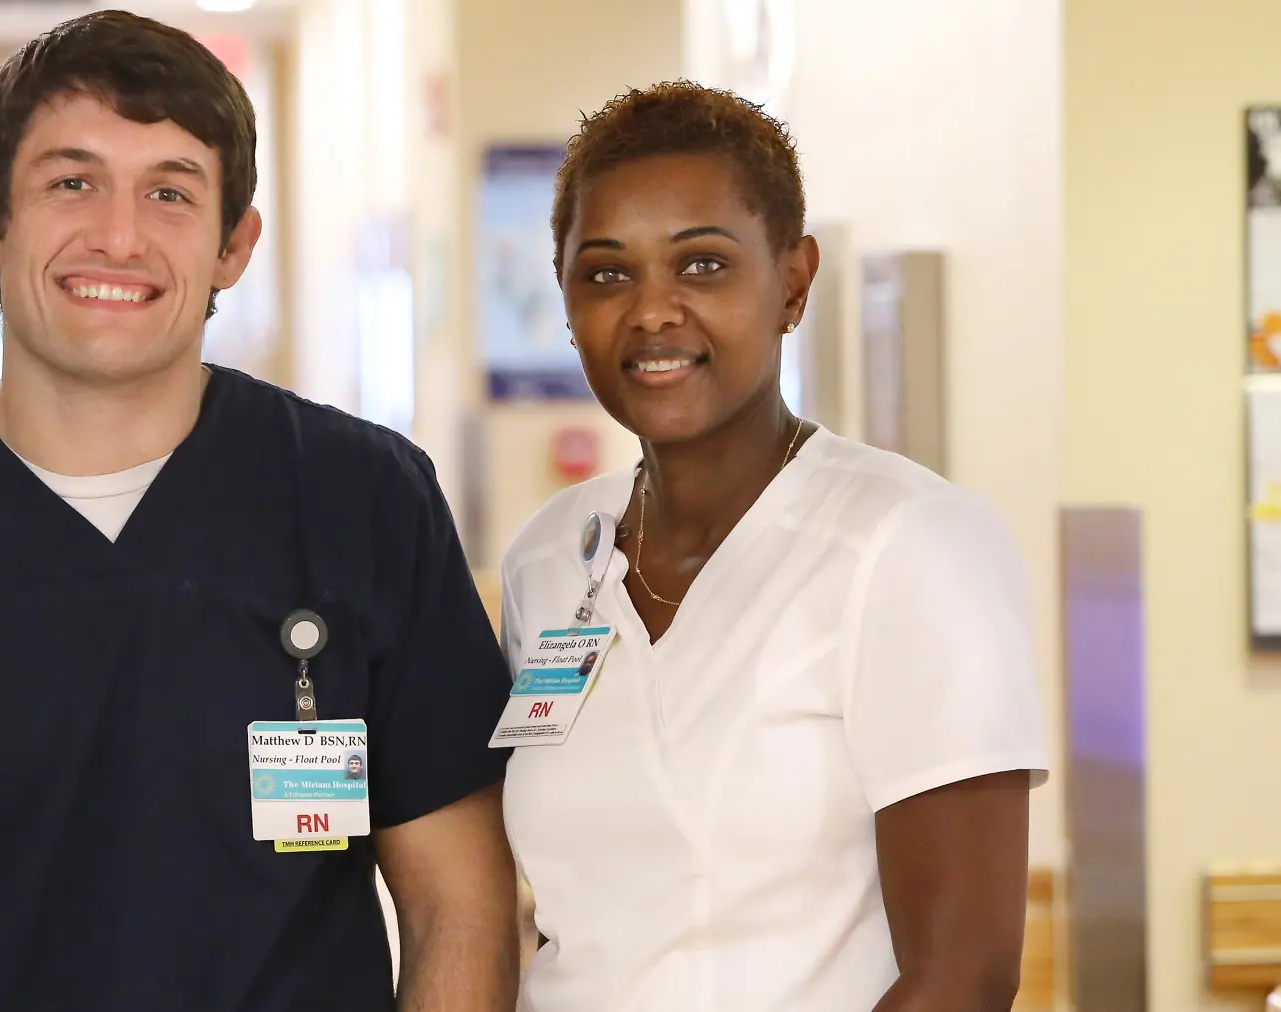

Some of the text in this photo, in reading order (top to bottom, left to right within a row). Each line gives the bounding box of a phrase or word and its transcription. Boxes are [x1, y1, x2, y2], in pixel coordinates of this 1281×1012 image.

[539, 638, 601, 652] Elizangela O RN
[528, 701, 554, 719] RN
[251, 735, 366, 748] Matthew D BSN,RN
[252, 754, 287, 766] Nursing
[295, 755, 318, 764] Float
[320, 755, 341, 764] Pool
[301, 781, 331, 789] Miriam
[332, 781, 366, 790] Hospital
[296, 813, 330, 833] RN
